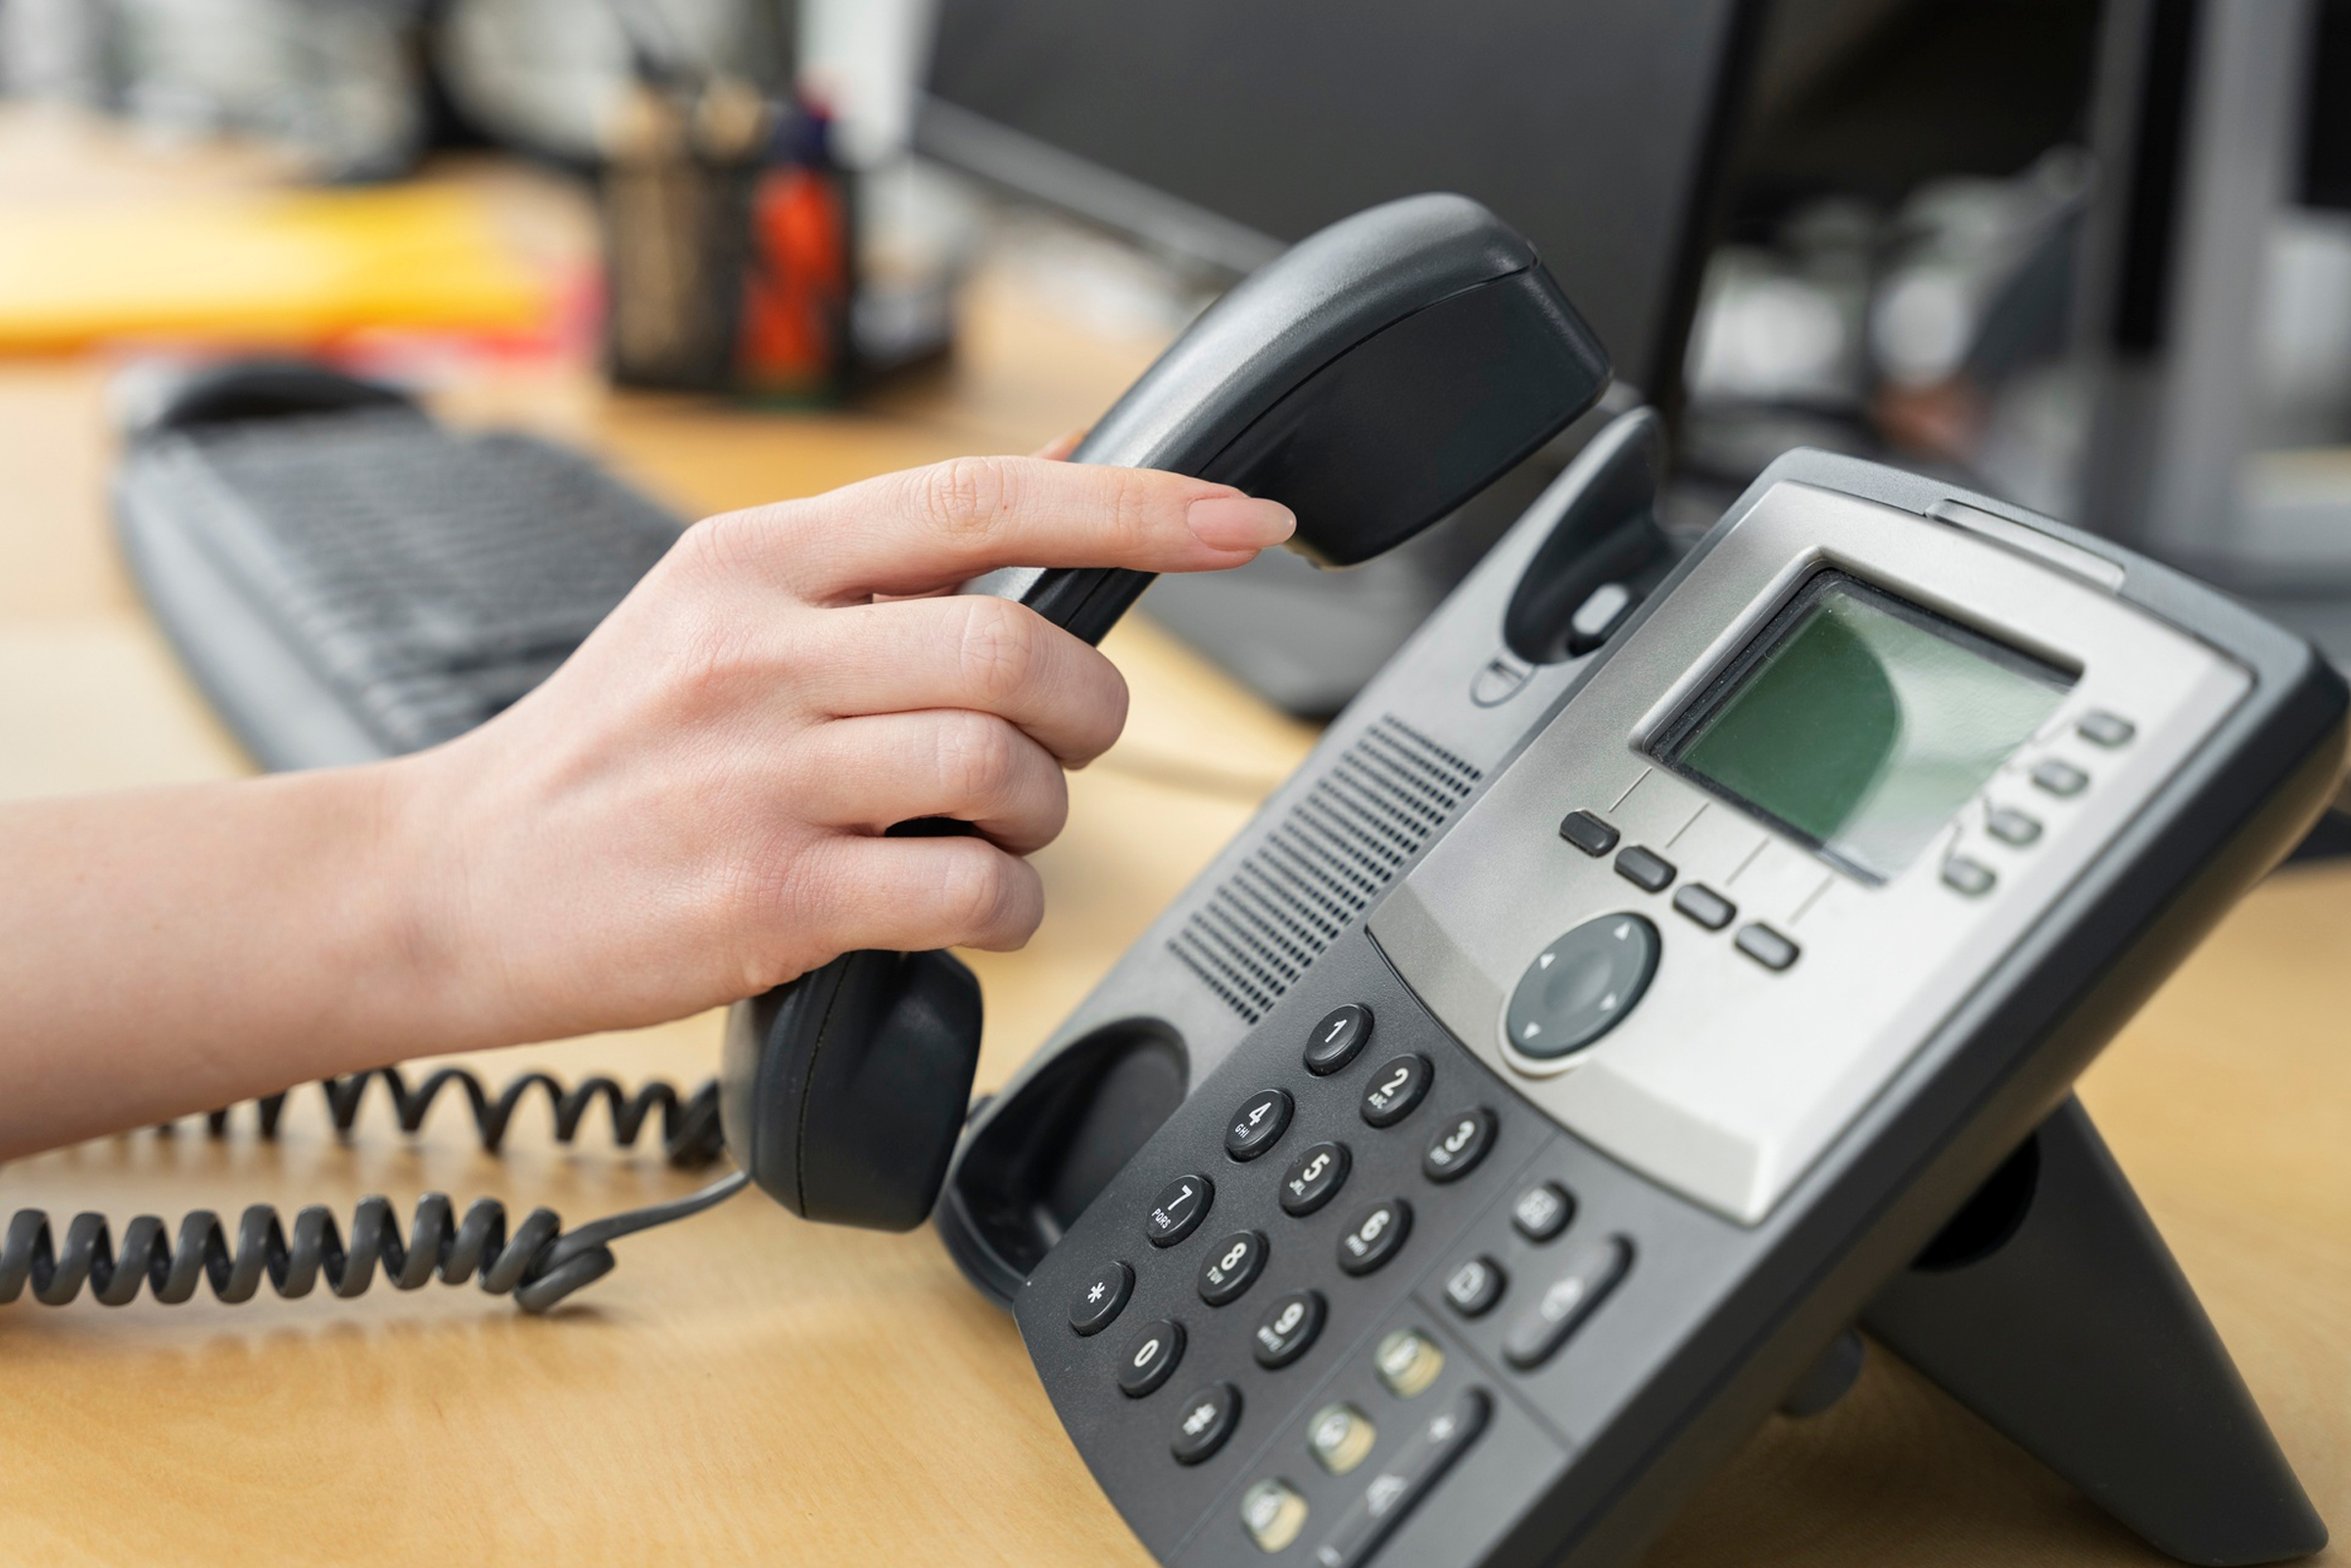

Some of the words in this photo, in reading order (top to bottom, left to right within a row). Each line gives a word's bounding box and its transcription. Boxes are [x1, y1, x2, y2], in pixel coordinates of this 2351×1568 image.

[1324, 1019, 1348, 1043] 1
[1380, 1068, 1409, 1097] 2
[1248, 1102, 1271, 1126] 4
[1367, 1092, 1389, 1110] ABC
[1234, 1123, 1250, 1138] GHI
[1445, 1120, 1475, 1152] 3
[1302, 1153, 1330, 1181] 5
[1167, 1184, 1193, 1211] 7
[1151, 1208, 1172, 1229] PQRS
[1360, 1210, 1390, 1241] 6
[1221, 1242, 1247, 1270] 8
[1274, 1302, 1305, 1335] 9
[1133, 1339, 1160, 1367] 0
